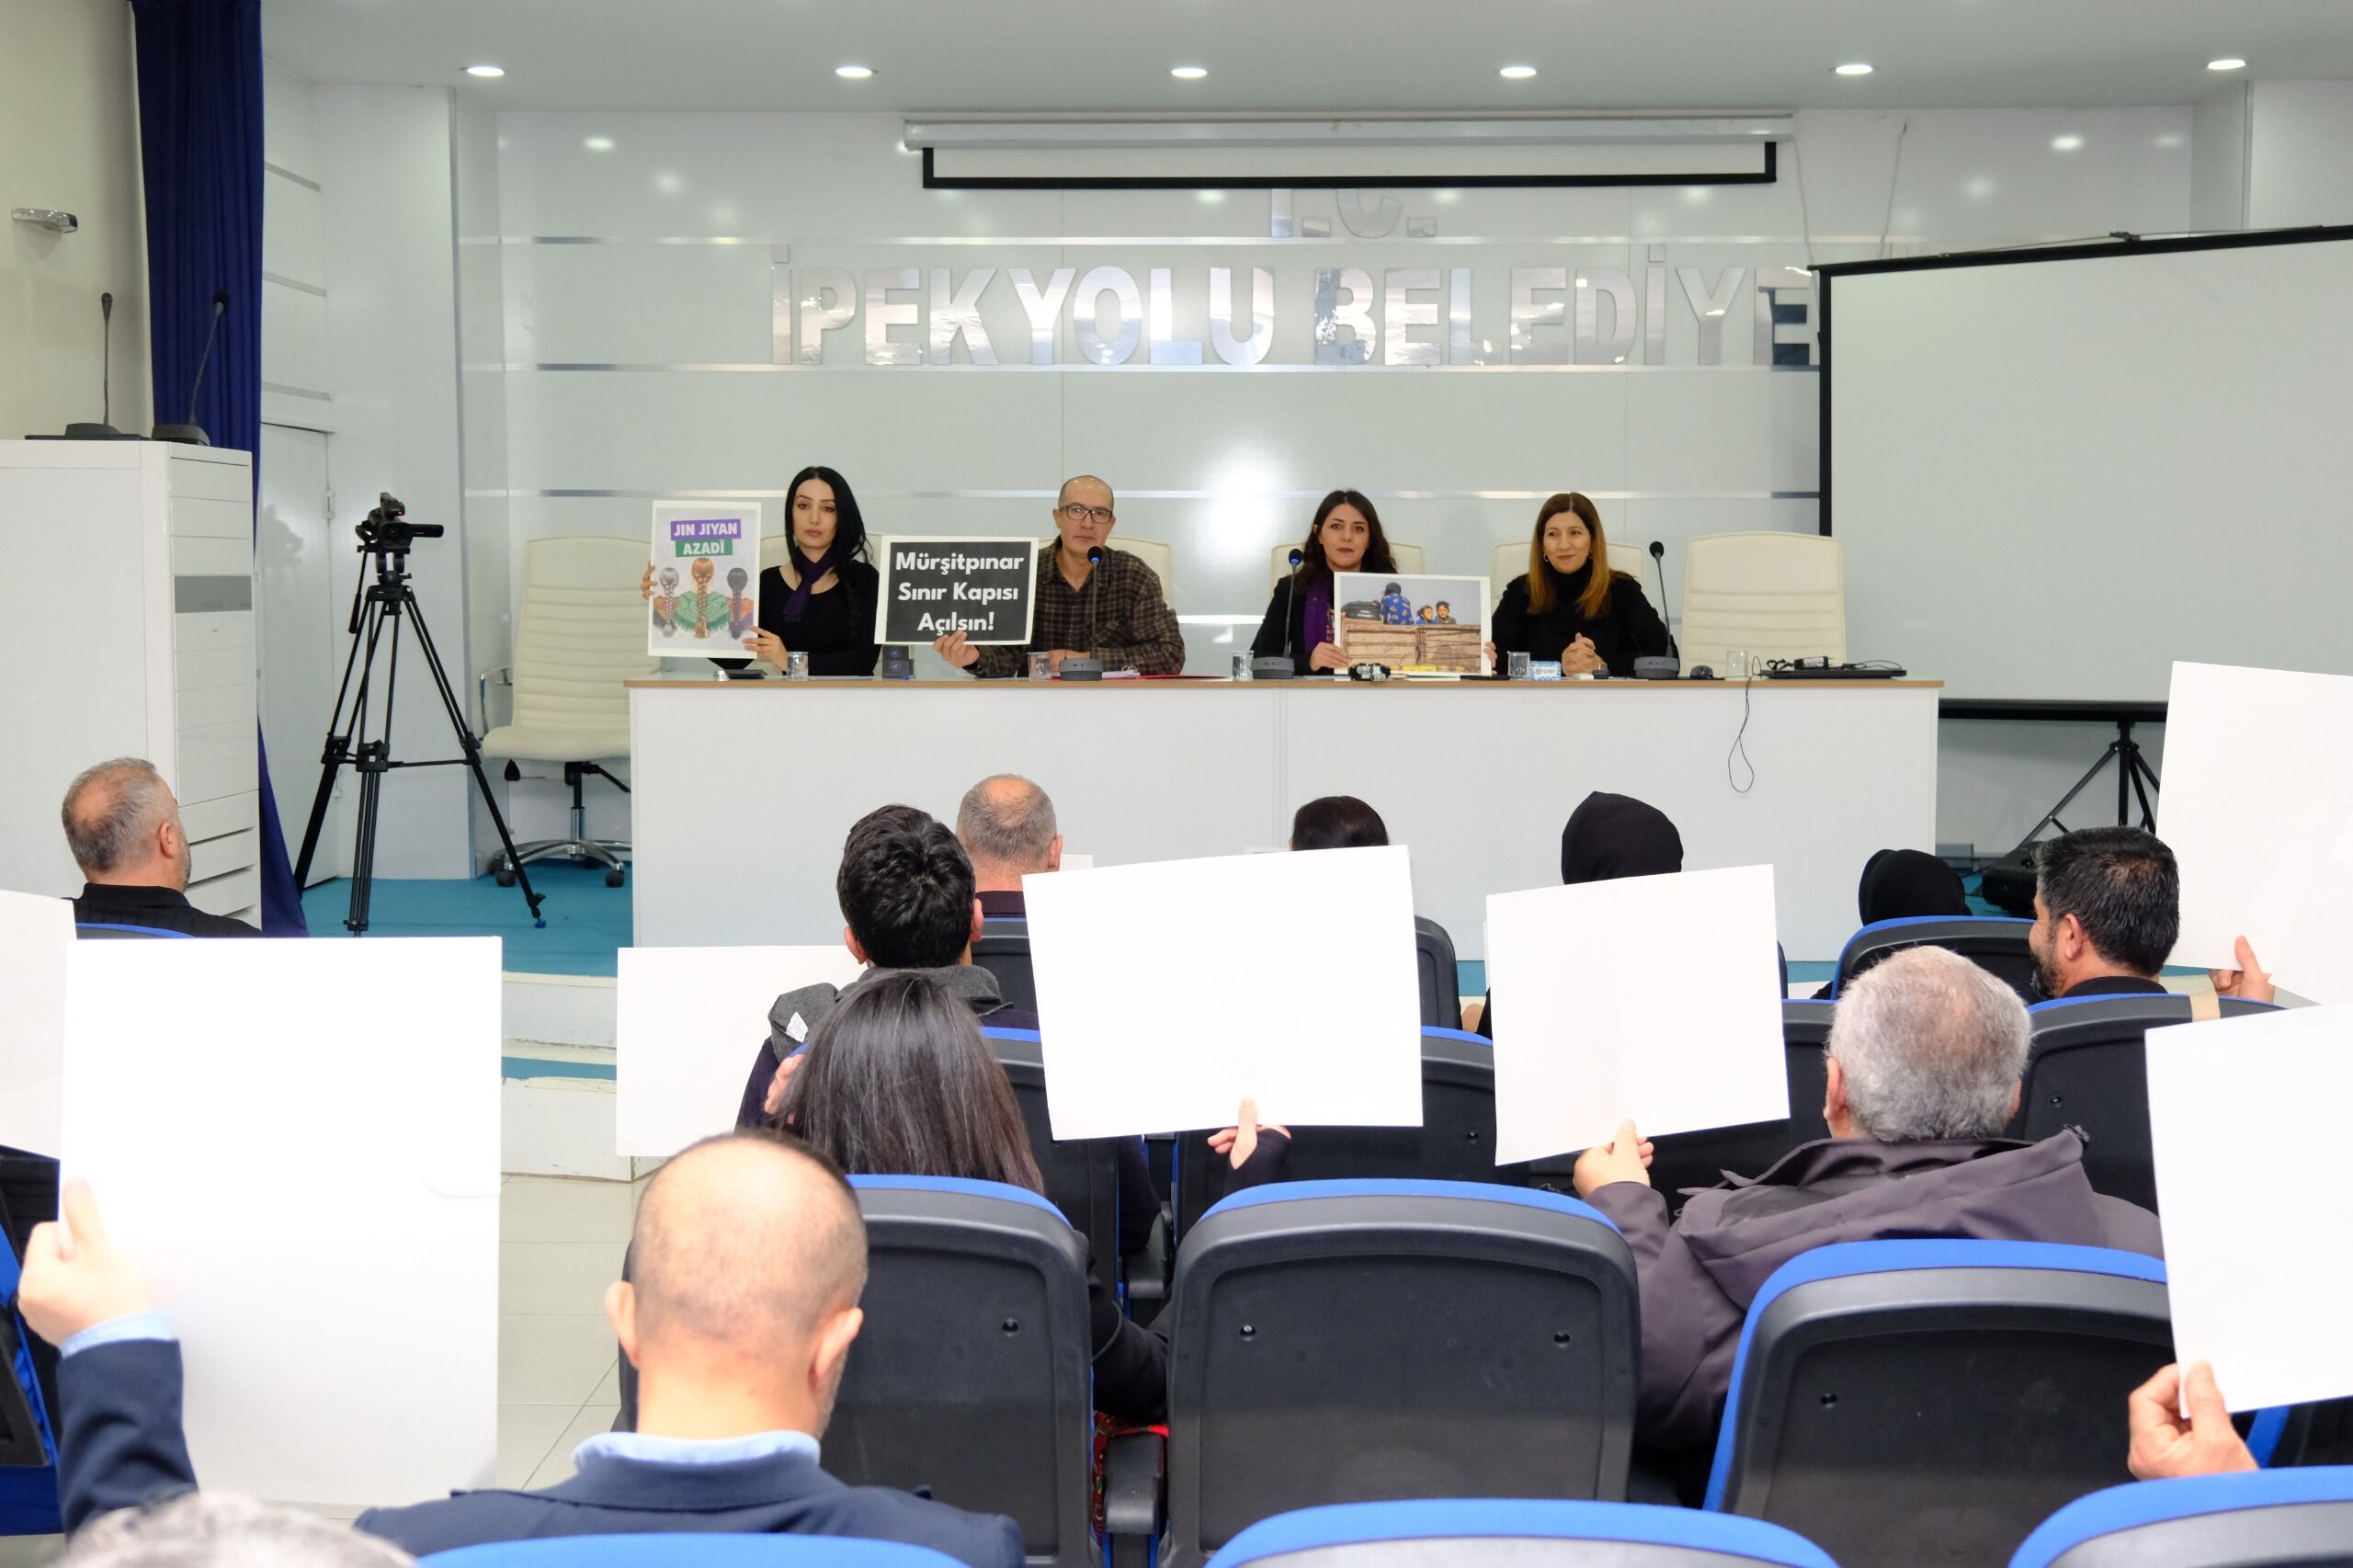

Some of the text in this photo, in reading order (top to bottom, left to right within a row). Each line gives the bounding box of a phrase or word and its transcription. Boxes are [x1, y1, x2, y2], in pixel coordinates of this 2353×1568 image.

[674, 522, 737, 536] JIN JIYAN
[683, 540, 725, 555] AZADÎ
[895, 551, 1025, 575] Mürşitpınar
[897, 582, 1018, 606] Sınır Kapısı
[916, 611, 995, 636] Açılsın!
